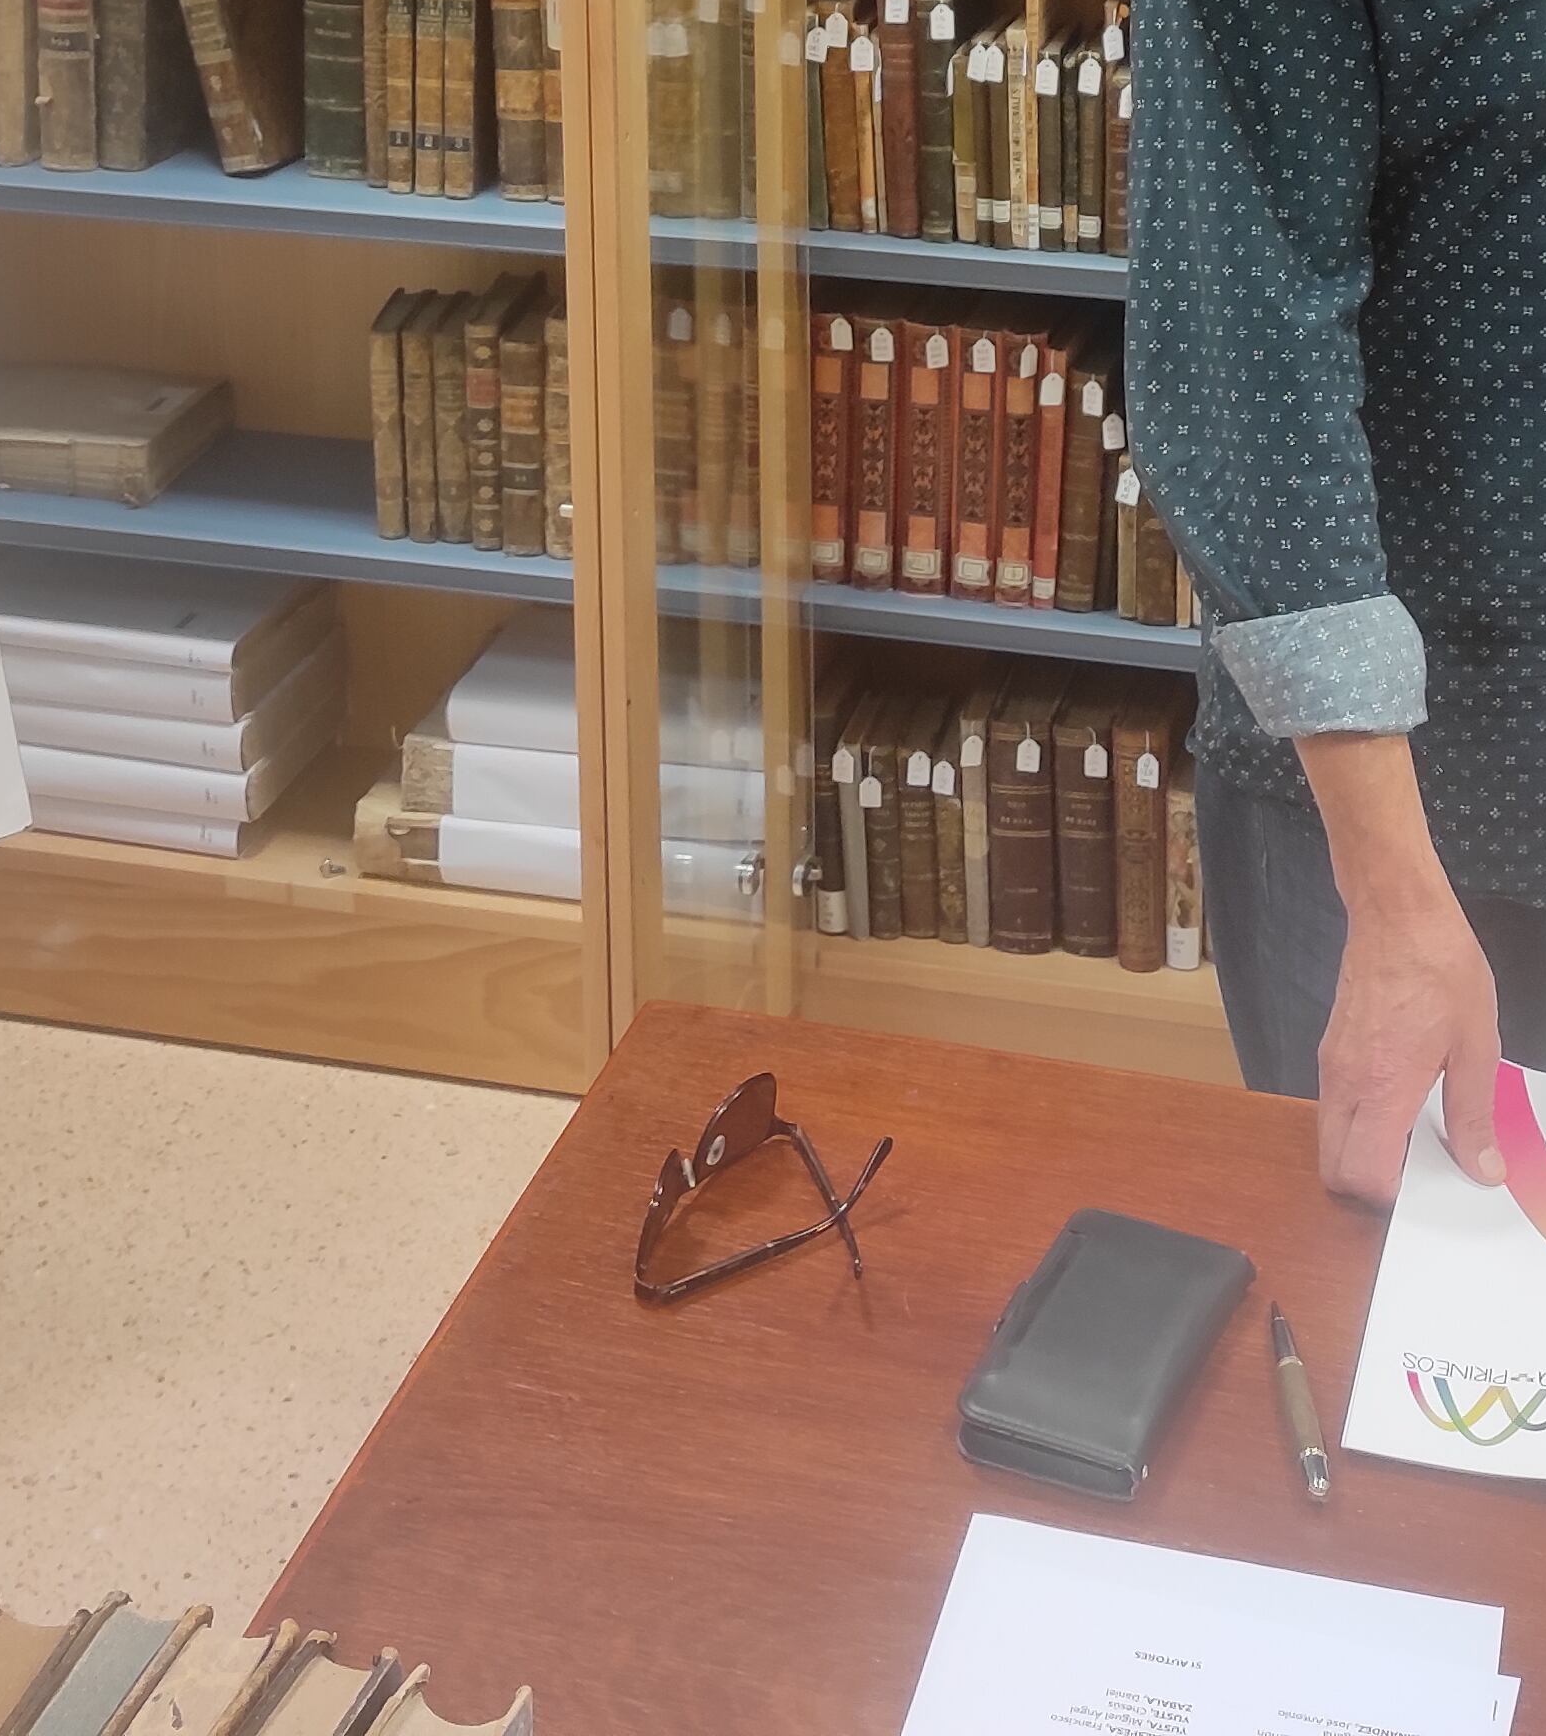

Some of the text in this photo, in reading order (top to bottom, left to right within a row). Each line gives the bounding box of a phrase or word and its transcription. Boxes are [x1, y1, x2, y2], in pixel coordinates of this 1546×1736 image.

[1402, 1351, 1509, 1386] PIRINEOS
[1133, 1649, 1189, 1668] AUTORES
[1105, 1687, 1194, 1714] ZABALA, Daniel
[1049, 1713, 1104, 1731] Francisco
[1104, 1711, 1143, 1728] Miguel
[1150, 1708, 1191, 1725] YUSTE,
[1277, 1710, 1324, 1725] Antonio
[1146, 1719, 1188, 1736] YUSTA,
